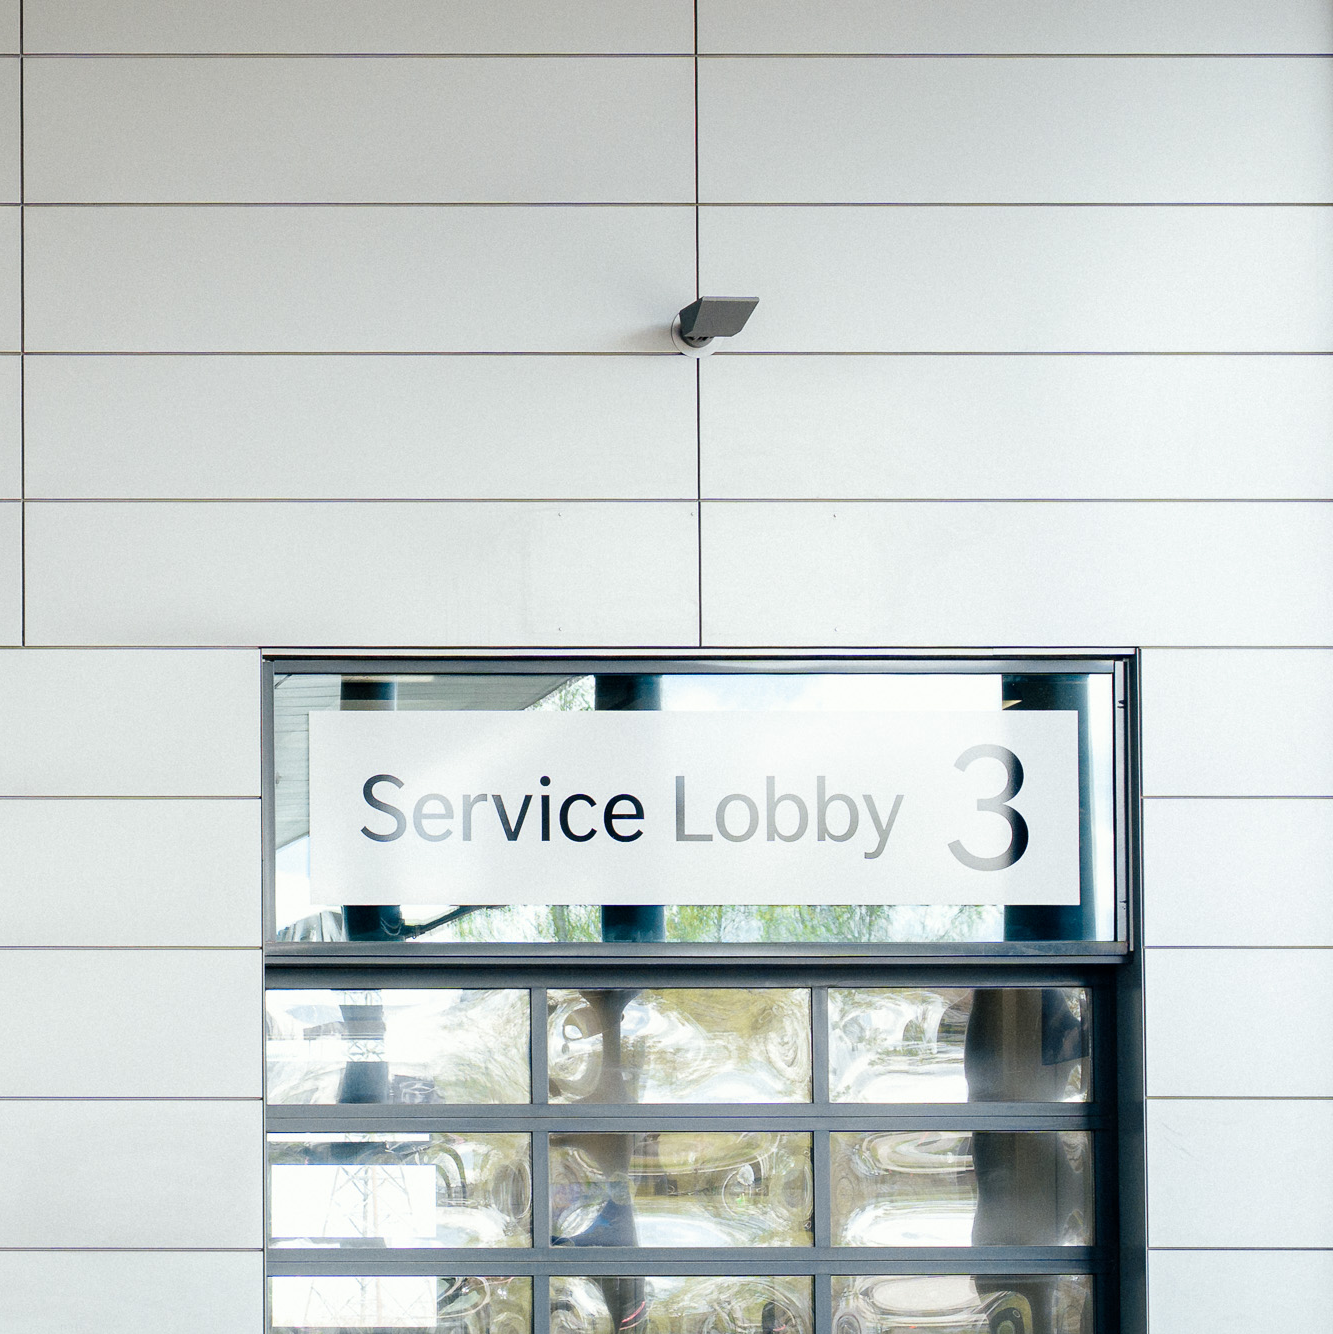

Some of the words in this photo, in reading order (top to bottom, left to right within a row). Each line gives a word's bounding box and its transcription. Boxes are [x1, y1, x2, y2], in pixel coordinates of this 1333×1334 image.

[360, 773, 645, 843] Service
[675, 775, 905, 860] Lobby
[946, 743, 1030, 872] 3
